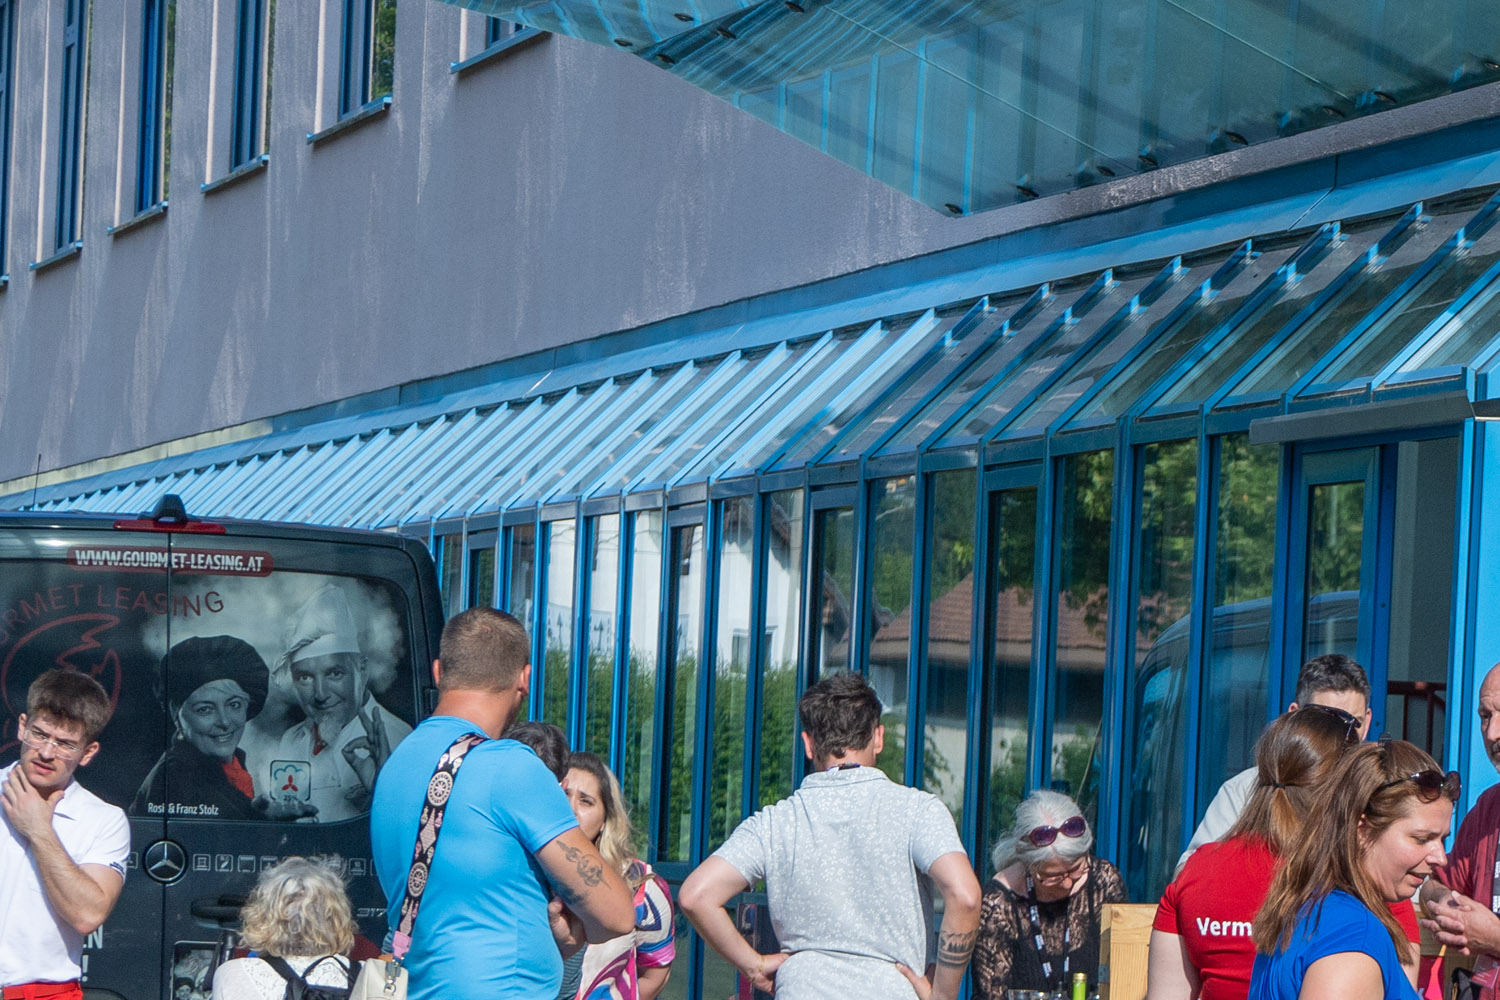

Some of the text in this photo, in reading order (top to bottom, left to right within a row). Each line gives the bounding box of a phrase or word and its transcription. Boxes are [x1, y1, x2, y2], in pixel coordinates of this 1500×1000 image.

[75, 550, 264, 572] WWW.GOURMET-LEASING.AT
[97, 584, 225, 617] LEASING
[168, 803, 175, 814] &
[176, 803, 198, 815] Franz
[199, 804, 220, 816] Stolz
[1196, 917, 1252, 936] Verm
